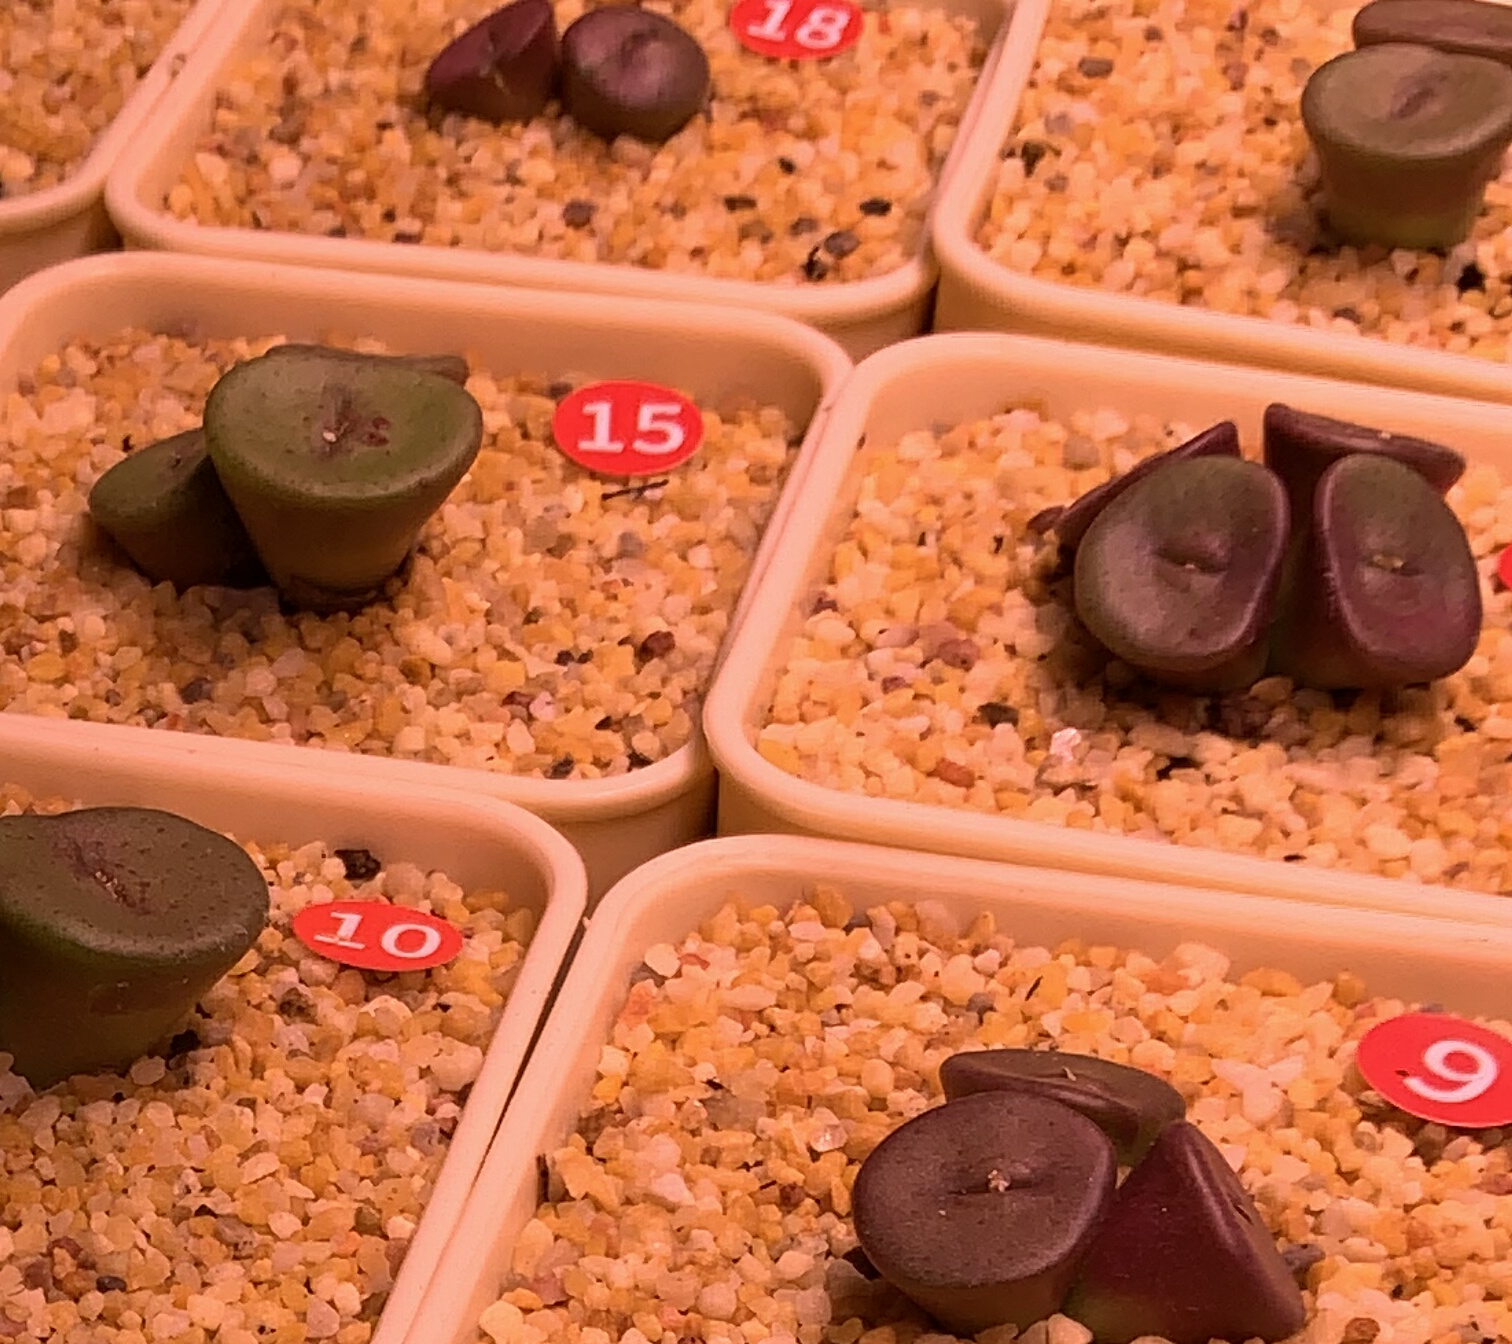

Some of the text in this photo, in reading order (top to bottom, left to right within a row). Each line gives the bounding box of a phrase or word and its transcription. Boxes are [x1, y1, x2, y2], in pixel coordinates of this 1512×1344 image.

[748, 0, 850, 49] 18
[577, 400, 684, 454] 15
[313, 910, 442, 958] 10
[1402, 1038, 1498, 1103] 9
